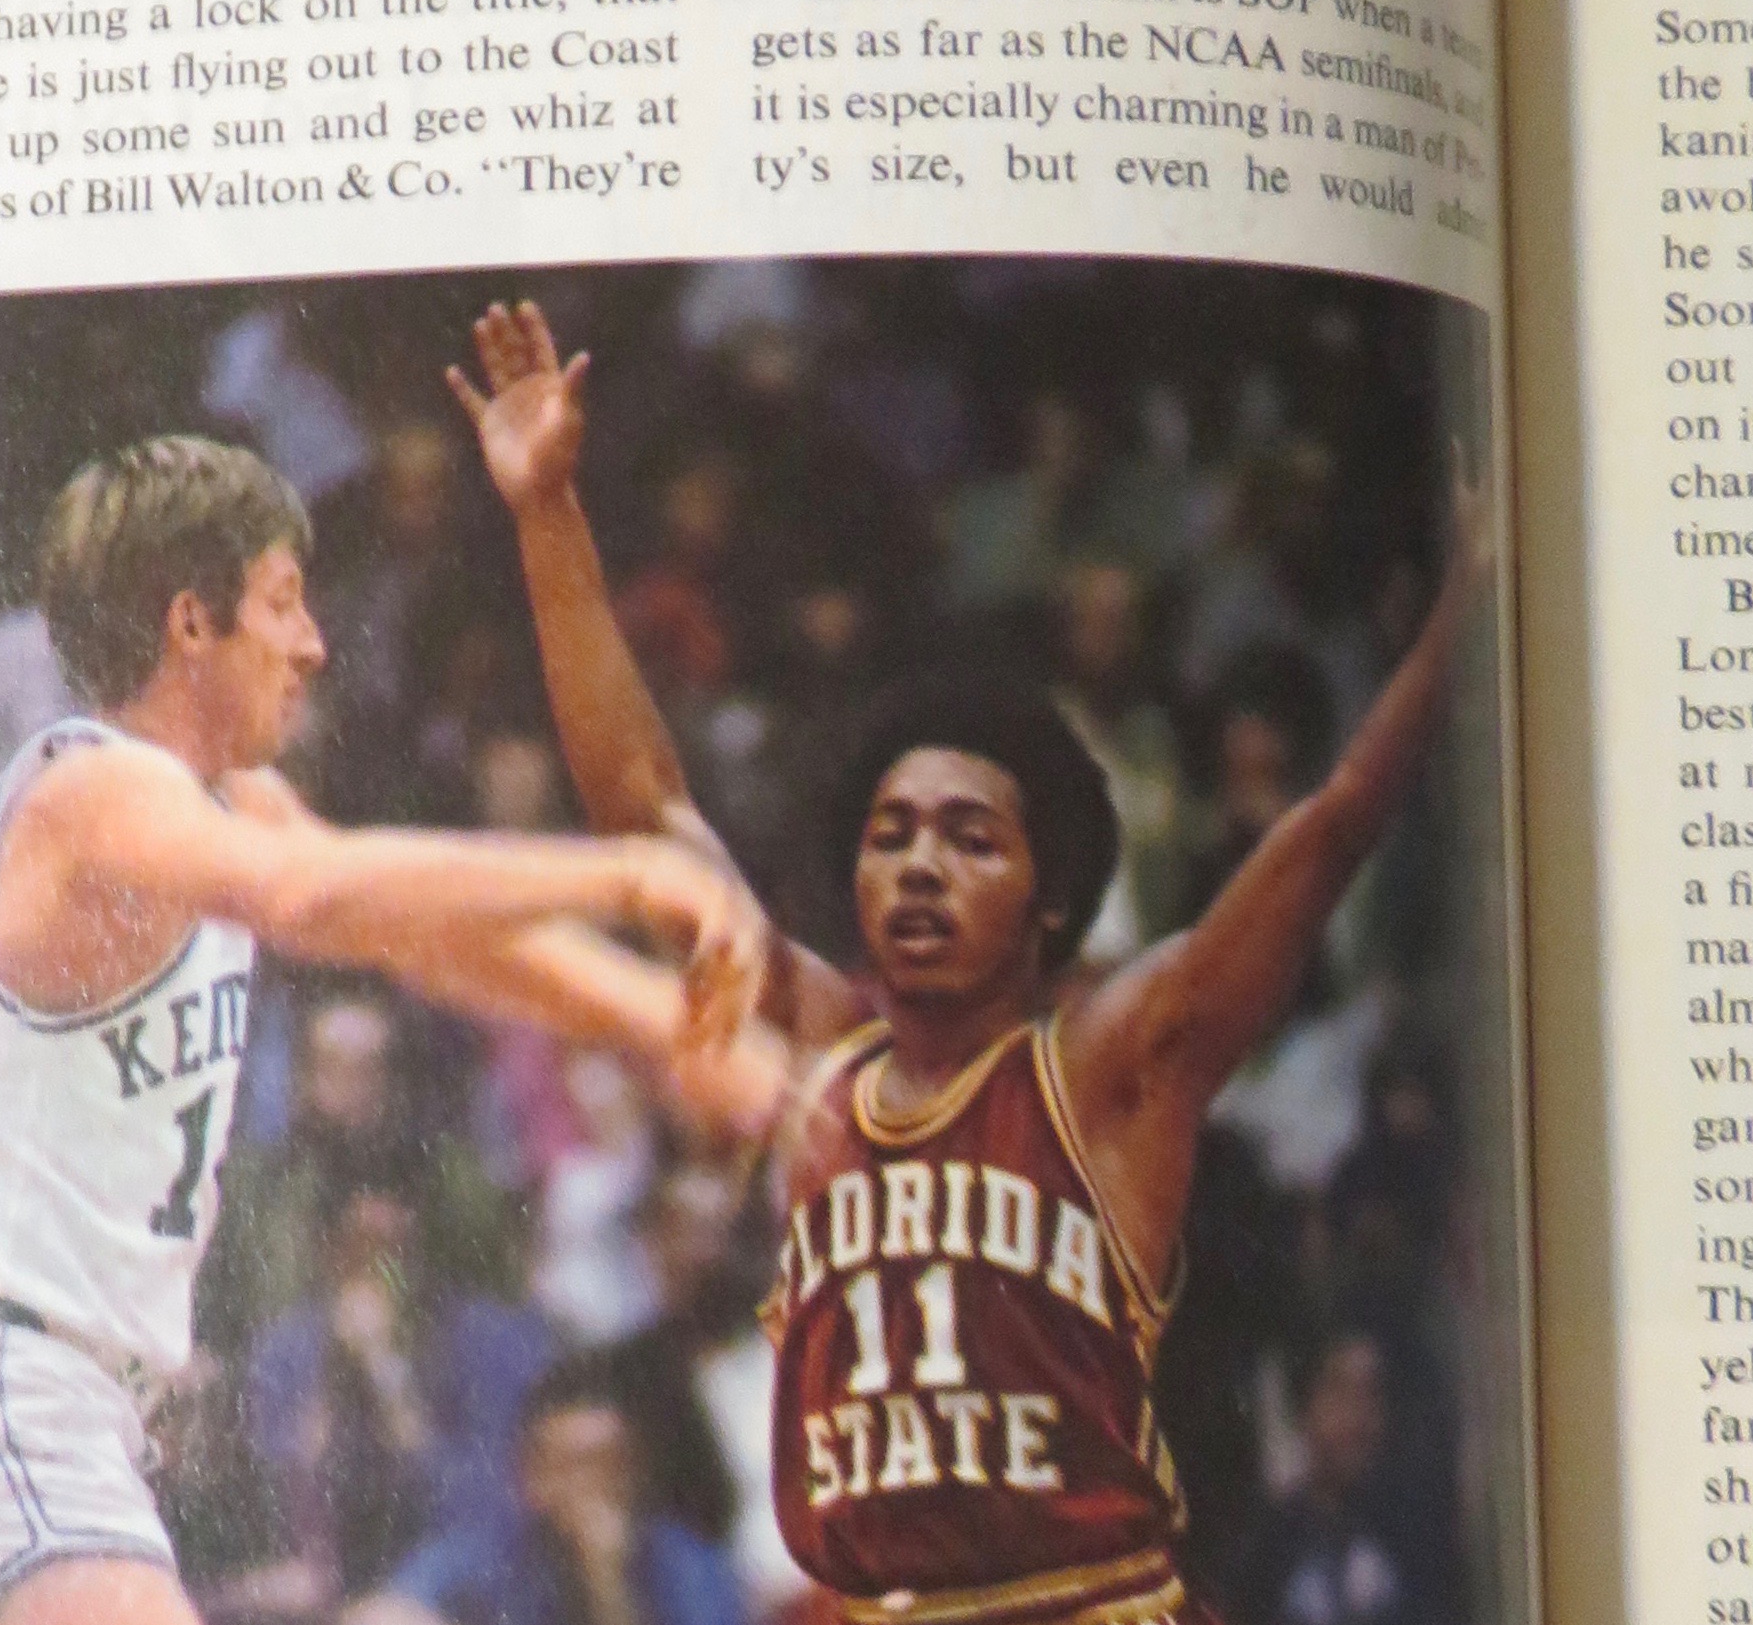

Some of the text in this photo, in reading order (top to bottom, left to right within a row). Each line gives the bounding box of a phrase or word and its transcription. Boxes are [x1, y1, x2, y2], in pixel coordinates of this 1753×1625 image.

[1664, 236, 1710, 270] he
[1666, 355, 1735, 385] out
[844, 1262, 966, 1395] 11
[803, 1392, 1064, 1507] STATE
